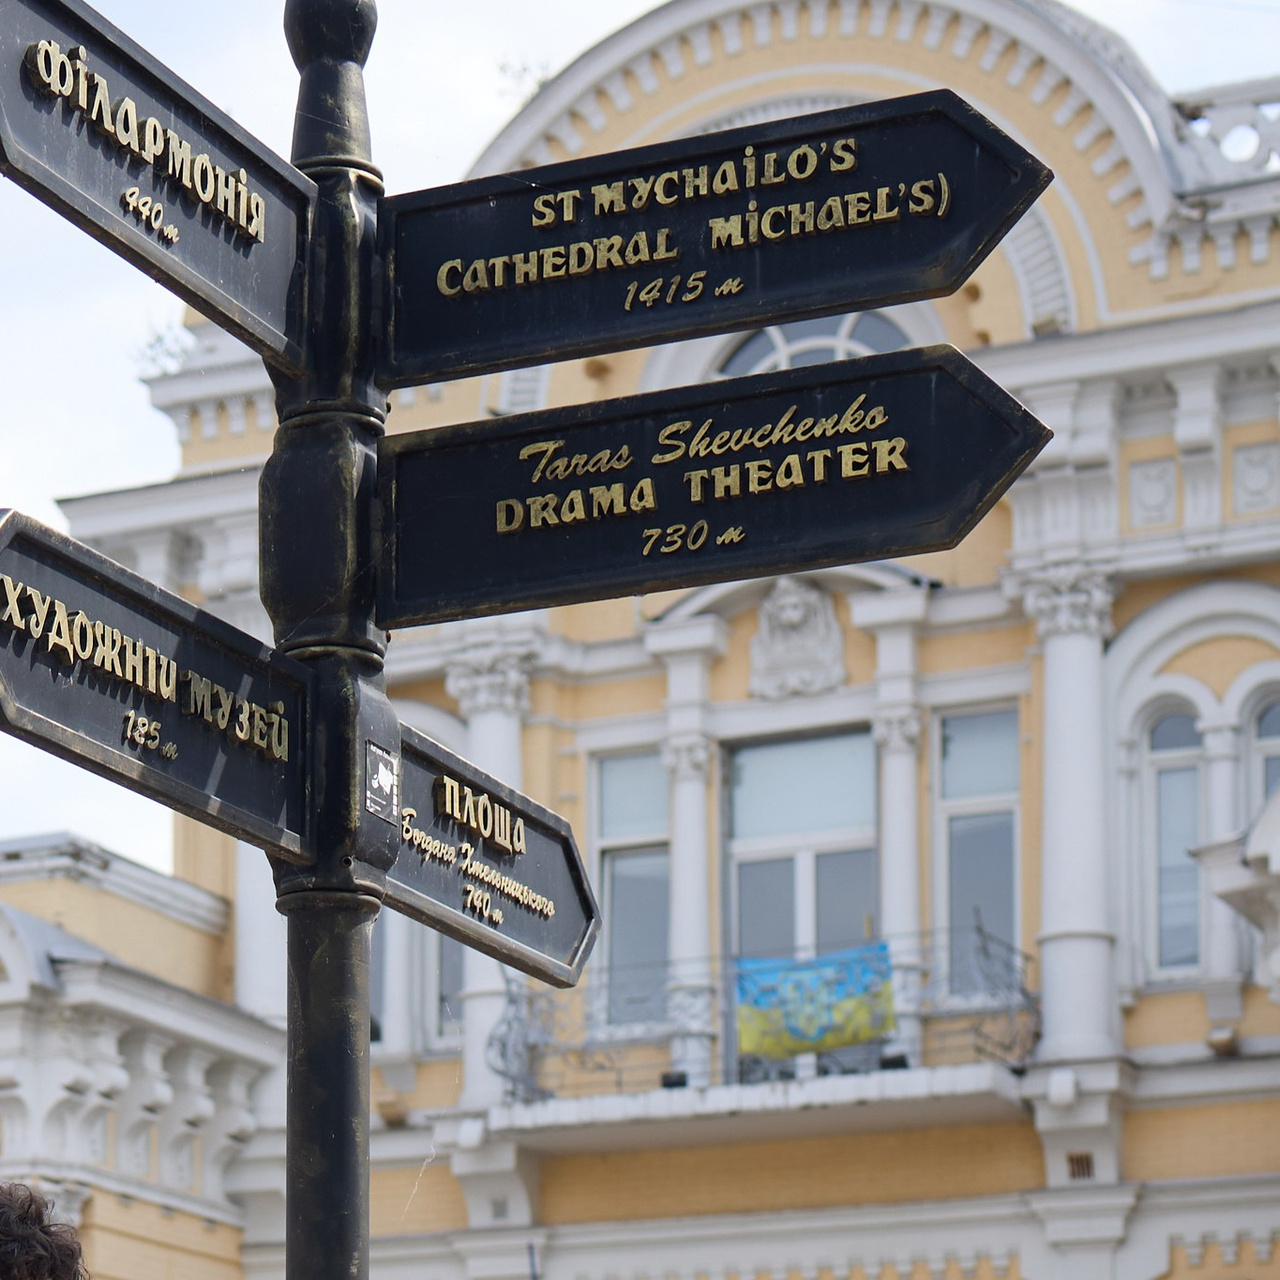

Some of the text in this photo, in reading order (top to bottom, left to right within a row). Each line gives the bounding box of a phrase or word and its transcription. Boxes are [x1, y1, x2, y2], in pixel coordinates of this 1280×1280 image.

[125, 187, 164, 230] 440
[532, 189, 582, 227] ST
[436, 228, 679, 296] CATHEDRAL
[624, 270, 707, 312] 1415
[519, 393, 889, 484] Taras Shevchenko
[496, 436, 911, 535] DRAMA THEATER
[642, 519, 709, 556] 730
[127, 709, 161, 750] 185
[188, 669, 290, 763] МУЗЕЙ
[443, 774, 527, 855] ПЛОЩА
[401, 807, 556, 917] Богдана Хмельницького
[466, 884, 491, 918] 740
